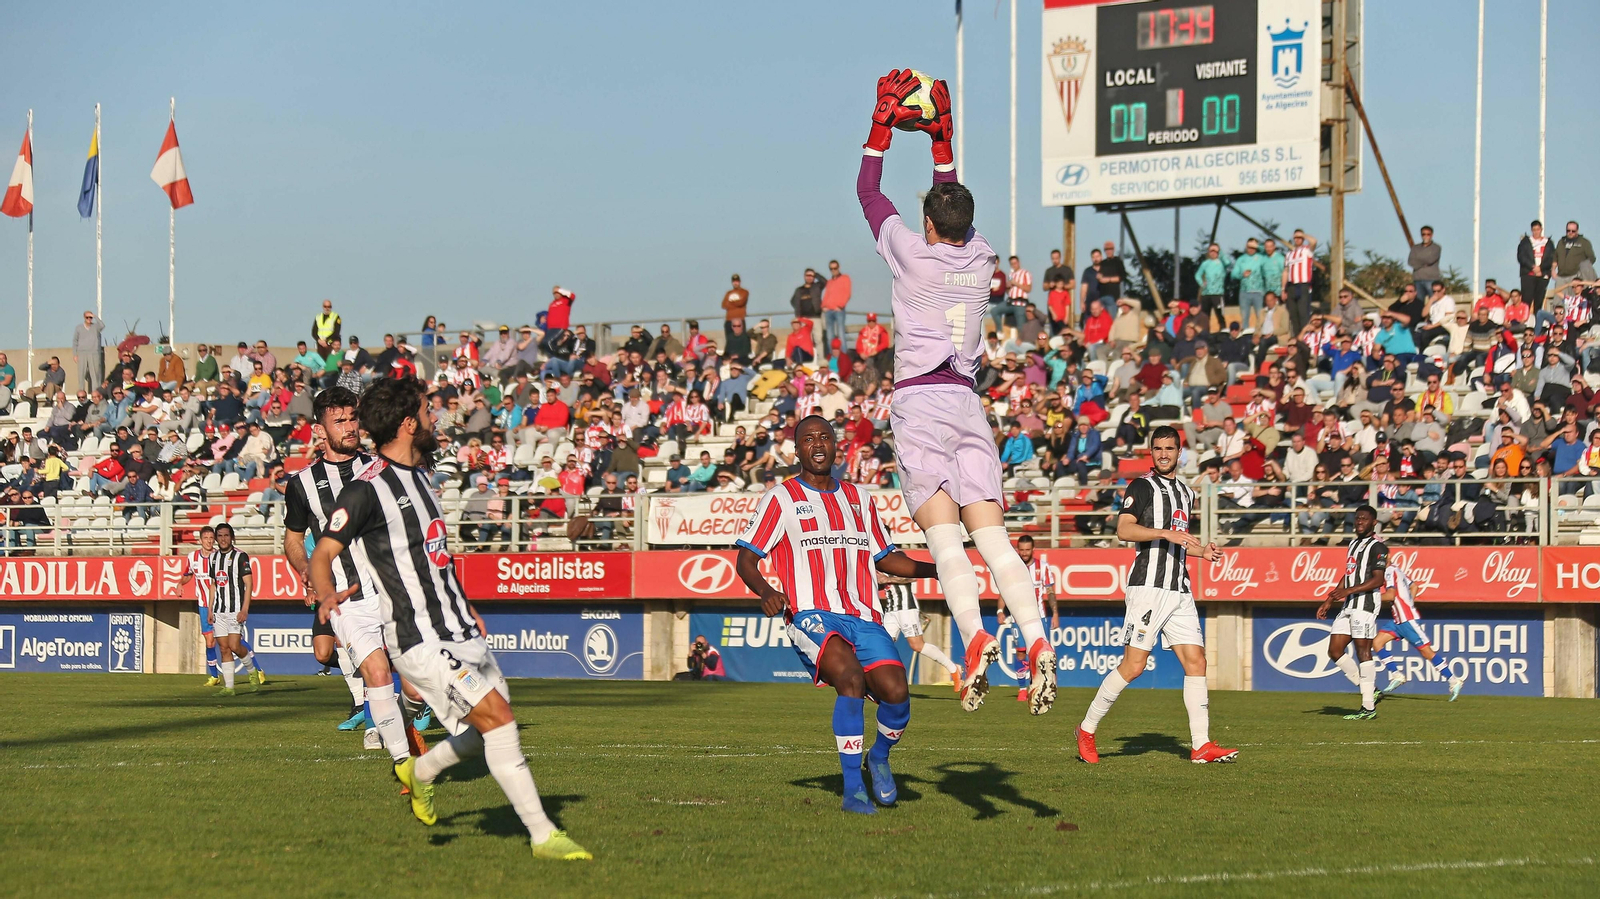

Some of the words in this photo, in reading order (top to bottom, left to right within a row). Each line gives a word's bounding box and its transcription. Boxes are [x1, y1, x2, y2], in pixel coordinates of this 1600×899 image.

[1105, 68, 1155, 87] LOCAL
[1196, 59, 1247, 80] VISITANTE
[1262, 90, 1313, 102] Ayuntamiento
[1275, 100, 1308, 111] Algeciras
[1110, 102, 1147, 143] 00
[1203, 94, 1240, 135] 00
[1147, 128, 1199, 145] PERIODO
[1099, 156, 1180, 176] PERMOTOR
[1184, 149, 1270, 169] ALGECIRAS
[1275, 147, 1302, 161] S.L.
[1111, 179, 1169, 196] SERVICIO
[1174, 176, 1223, 190] OFICIAL
[1239, 171, 1258, 186] 956
[1261, 169, 1280, 183] 665
[1284, 167, 1303, 181] 167
[944, 272, 978, 286] E.ROYO
[944, 302, 966, 351] 1
[800, 534, 869, 547] master.hous
[0, 561, 120, 595] ADILLA
[497, 557, 605, 580] Socialistas
[1209, 551, 1259, 597] Okay
[1291, 551, 1339, 597] Okay
[1482, 551, 1537, 598] Okay
[1556, 563, 1600, 589] HO
[497, 583, 507, 594] de
[509, 583, 550, 595] Algeciras
[23, 614, 59, 623] MOBILIARIO
[59, 614, 68, 622] DE
[68, 614, 94, 623] OFICINA
[111, 615, 133, 625] GRUPO
[581, 607, 621, 620] ŠKODA
[1141, 609, 1152, 626] 4
[20, 637, 103, 662] AlgeToner
[485, 634, 517, 649] ema
[520, 629, 569, 650] Motor
[440, 648, 462, 670] 3
[1059, 655, 1075, 671] de
